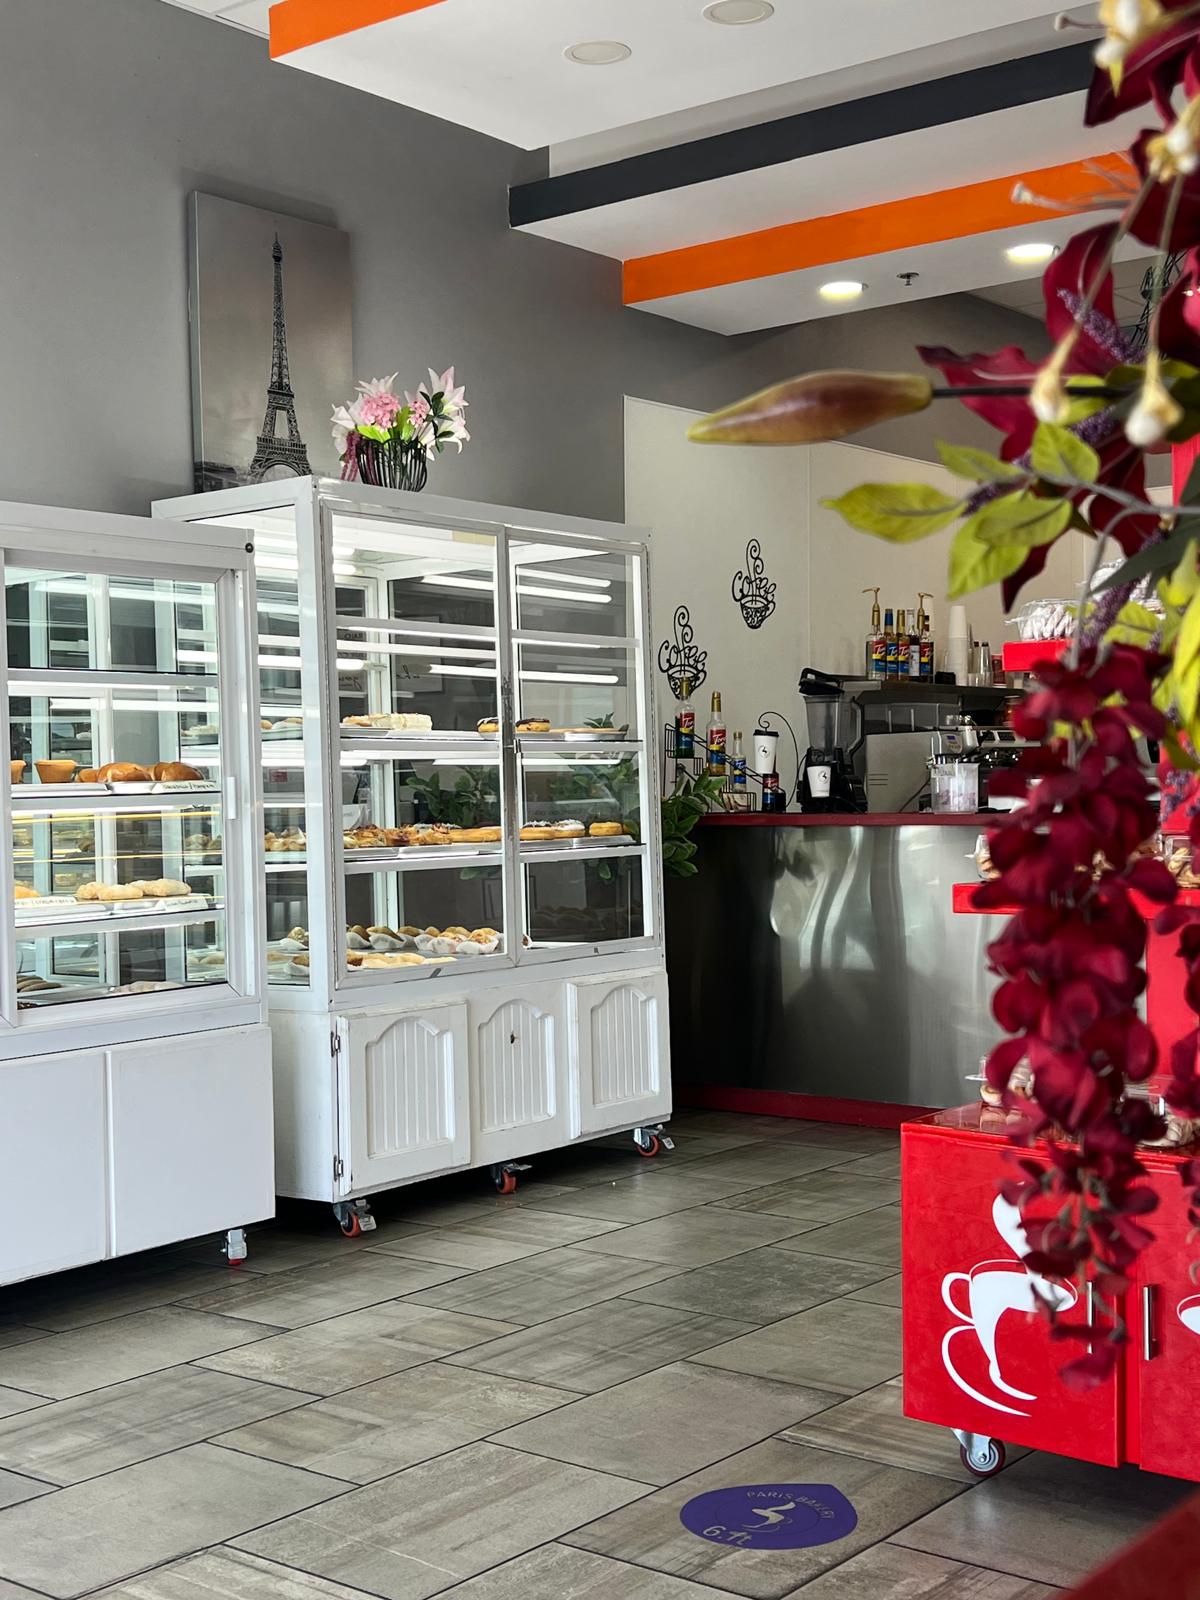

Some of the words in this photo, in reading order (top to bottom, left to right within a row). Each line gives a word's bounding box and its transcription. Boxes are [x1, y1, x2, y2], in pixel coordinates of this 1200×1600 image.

[731, 558, 777, 605] Coffee
[658, 625, 708, 675] Coffee
[746, 1491, 795, 1500] PARIS
